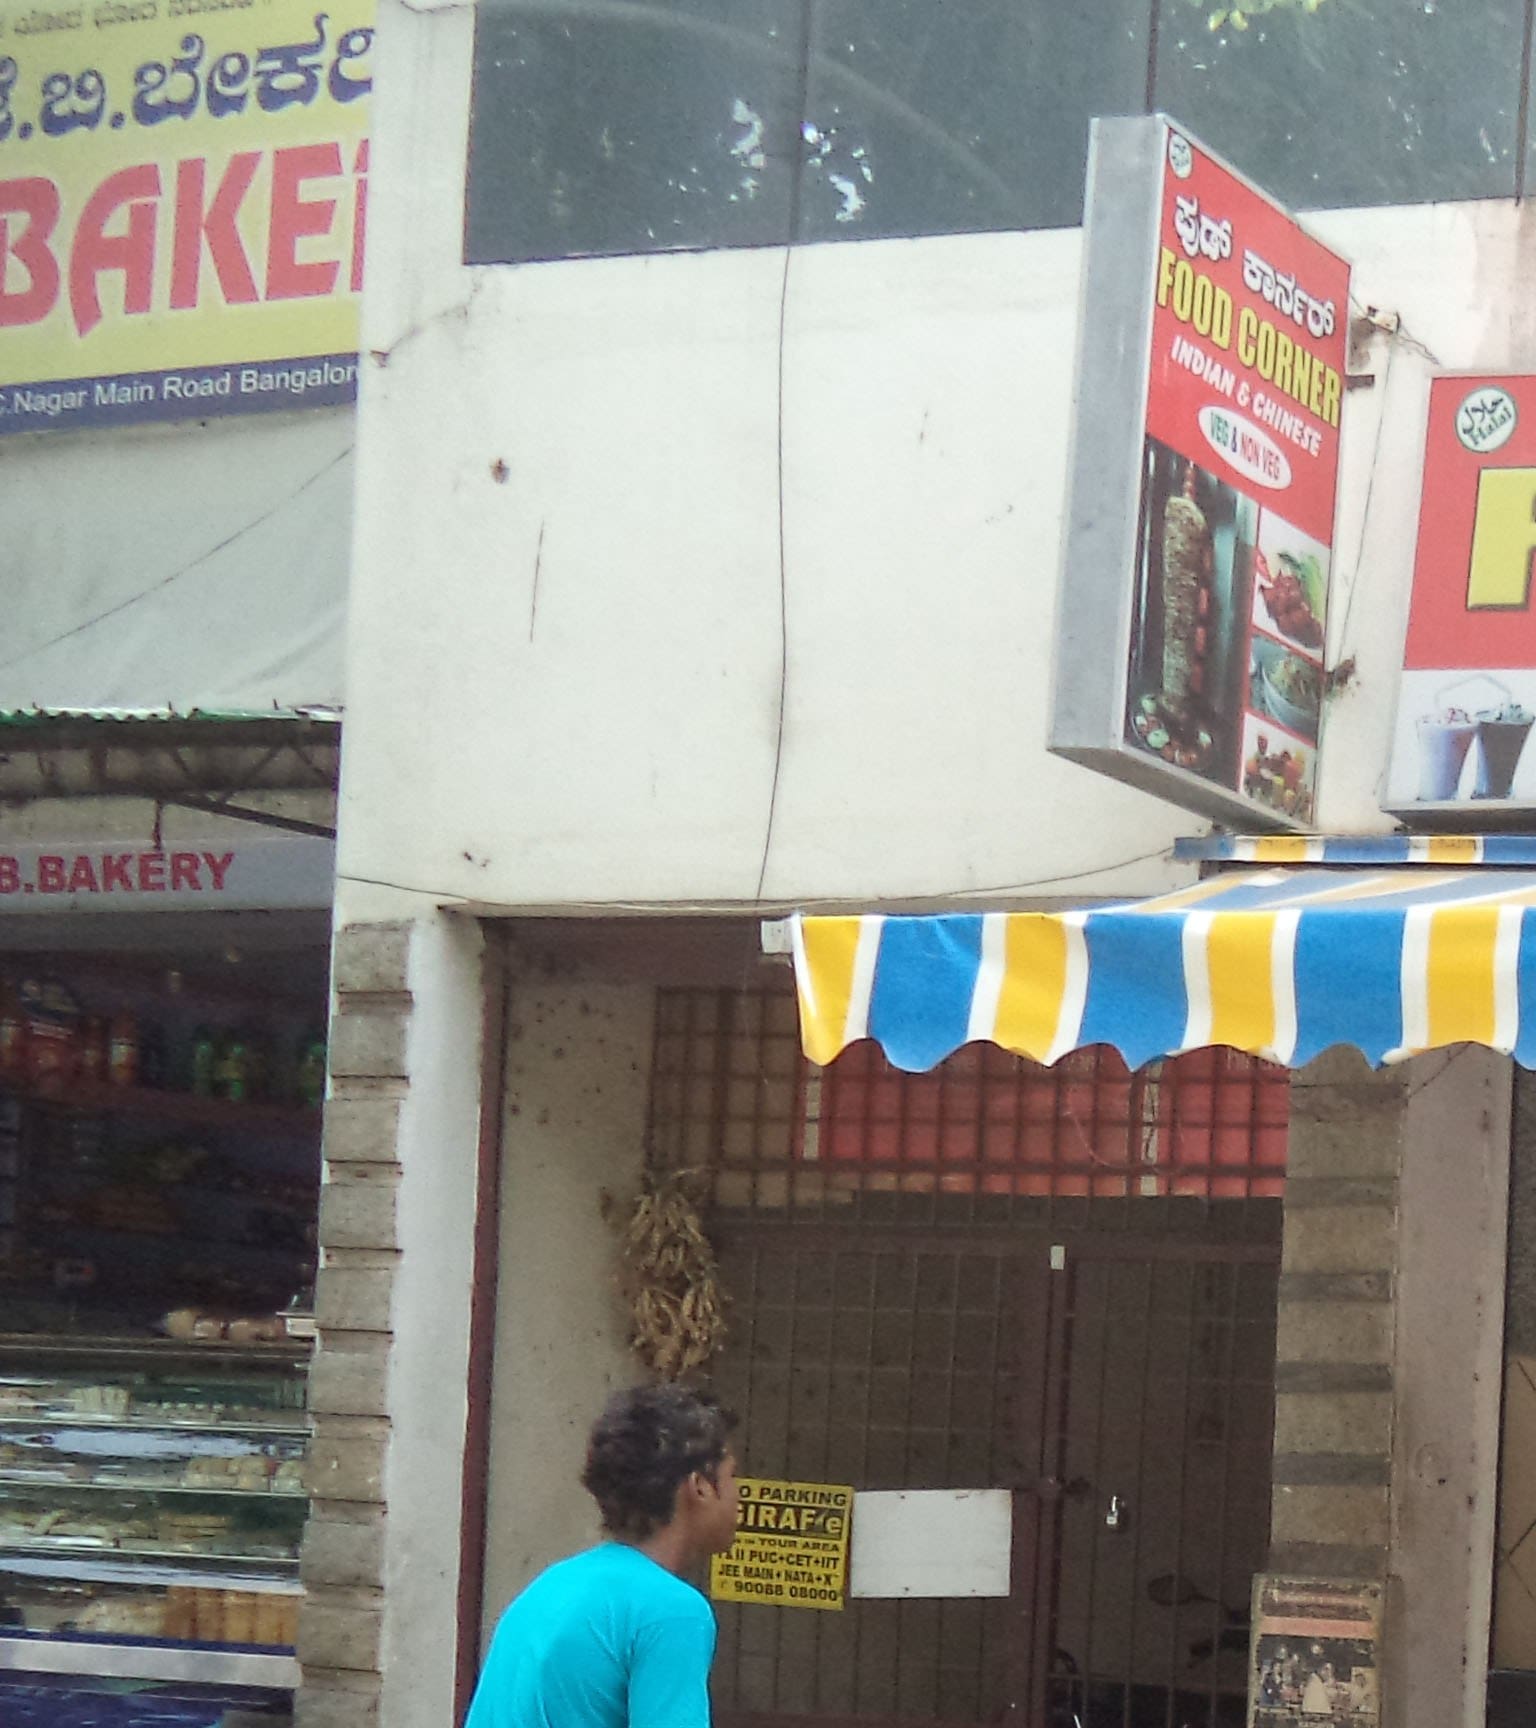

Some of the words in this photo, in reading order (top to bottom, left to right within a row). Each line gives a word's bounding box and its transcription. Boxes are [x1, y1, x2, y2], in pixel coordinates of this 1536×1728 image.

[0, 139, 369, 338] BAKE
[1157, 246, 1232, 351] FOOD
[1237, 307, 1341, 428] CORNER
[94, 380, 155, 407] Main
[163, 371, 232, 401] Road
[1171, 335, 1235, 398] INDIAN
[1237, 381, 1249, 407] &
[1252, 392, 1323, 458] CHINESE
[1211, 412, 1229, 448] VEG
[1261, 448, 1280, 481] VEG
[760, 1487, 847, 1507] PARKING
[758, 1537, 797, 1548] YOUR
[802, 1541, 839, 1552] AREA
[718, 1564, 740, 1577] JEE
[743, 1565, 774, 1580] MAIN
